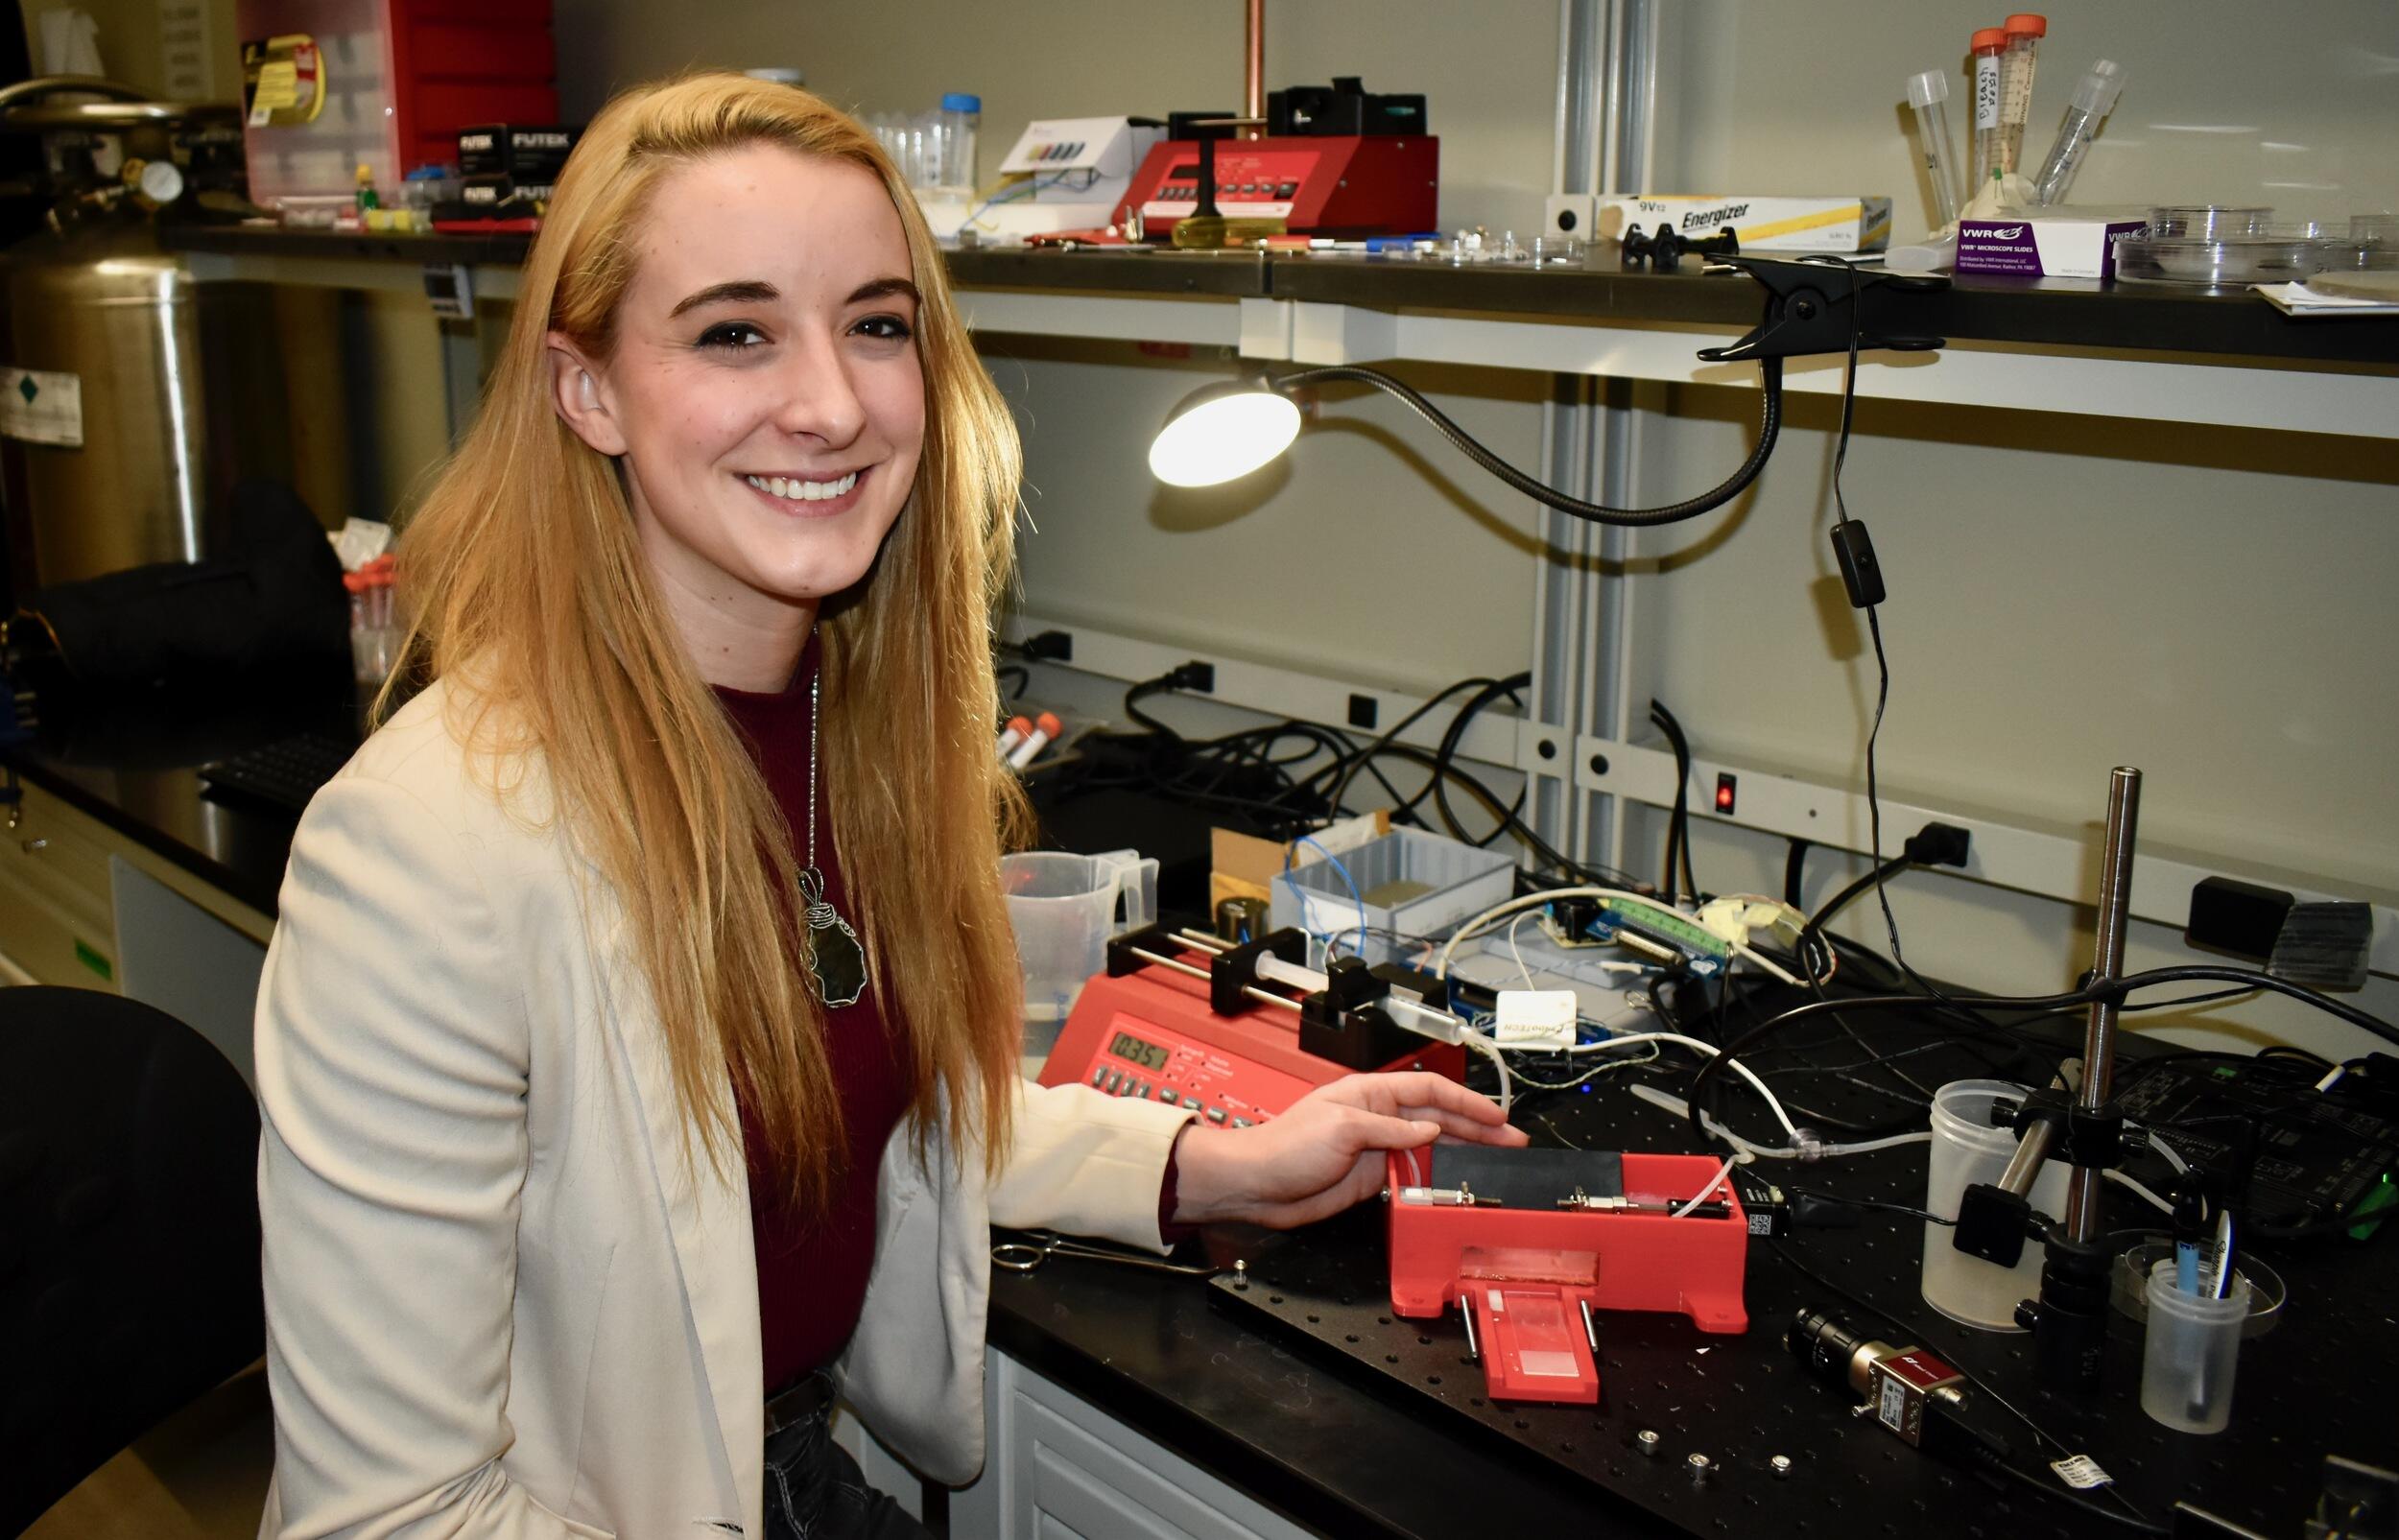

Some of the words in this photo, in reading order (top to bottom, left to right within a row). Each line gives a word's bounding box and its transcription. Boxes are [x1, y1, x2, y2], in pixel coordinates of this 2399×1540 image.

[1979, 66, 1990, 120] Bleach
[512, 132, 569, 148] FUTEK
[1681, 202, 1749, 229] Energizer
[1962, 228, 1993, 239] VWR
[2211, 1240, 2227, 1276] Sharpie
